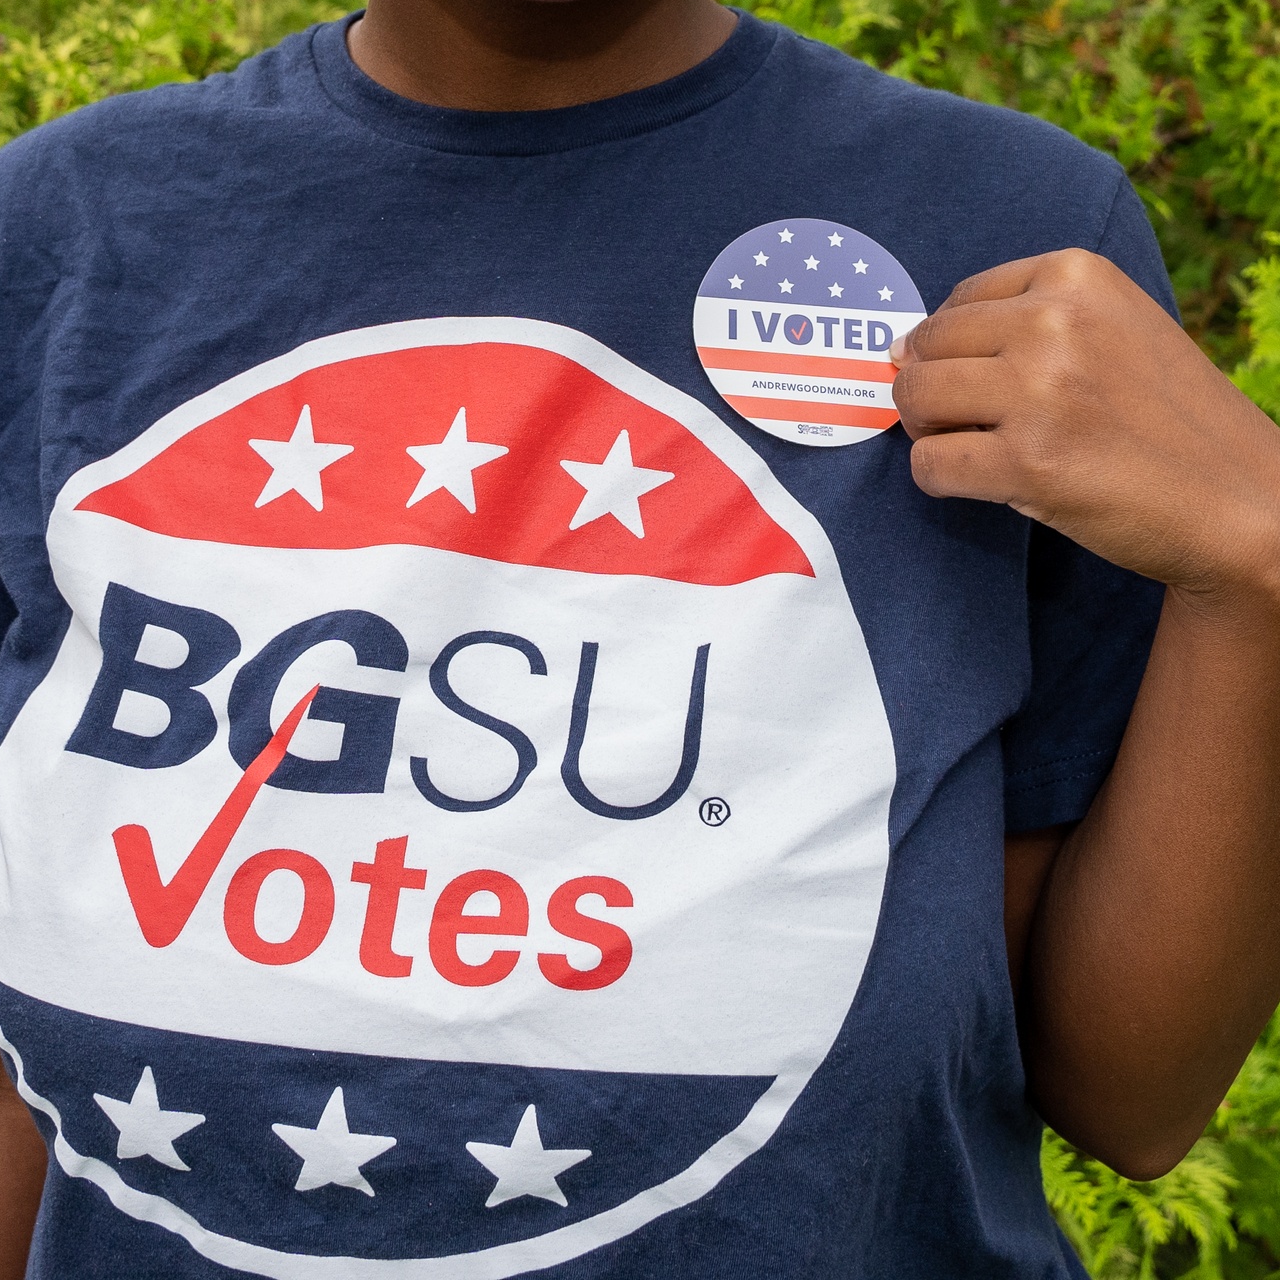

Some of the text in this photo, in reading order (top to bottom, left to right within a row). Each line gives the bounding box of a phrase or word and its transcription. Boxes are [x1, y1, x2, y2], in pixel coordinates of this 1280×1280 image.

[728, 308, 894, 352] I VOTED
[751, 380, 876, 398] ANDREWGOODMAN.ORG
